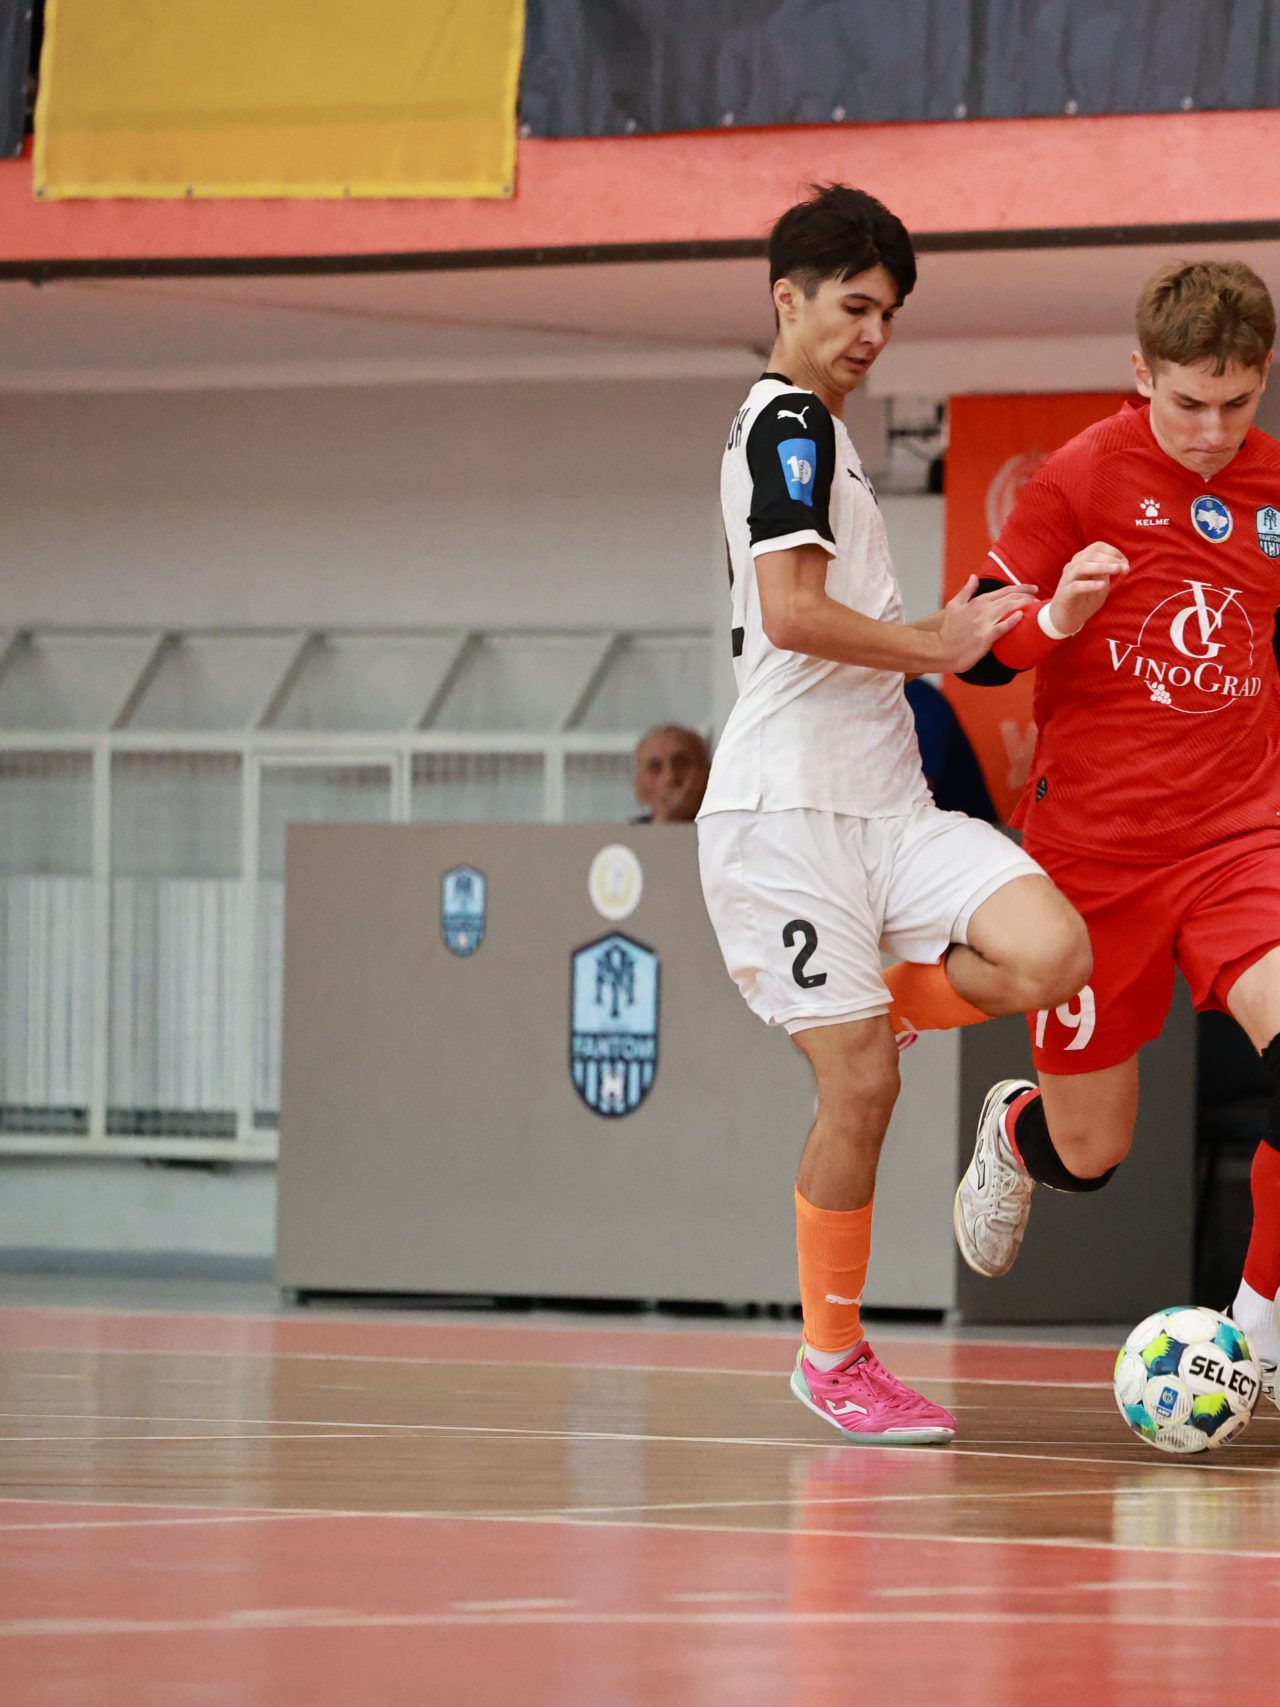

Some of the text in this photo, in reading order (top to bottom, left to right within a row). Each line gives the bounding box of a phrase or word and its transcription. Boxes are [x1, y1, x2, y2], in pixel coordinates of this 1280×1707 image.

[1135, 518, 1170, 527] KELME
[782, 918, 828, 989] 2
[1189, 1355, 1257, 1401] SELECT
